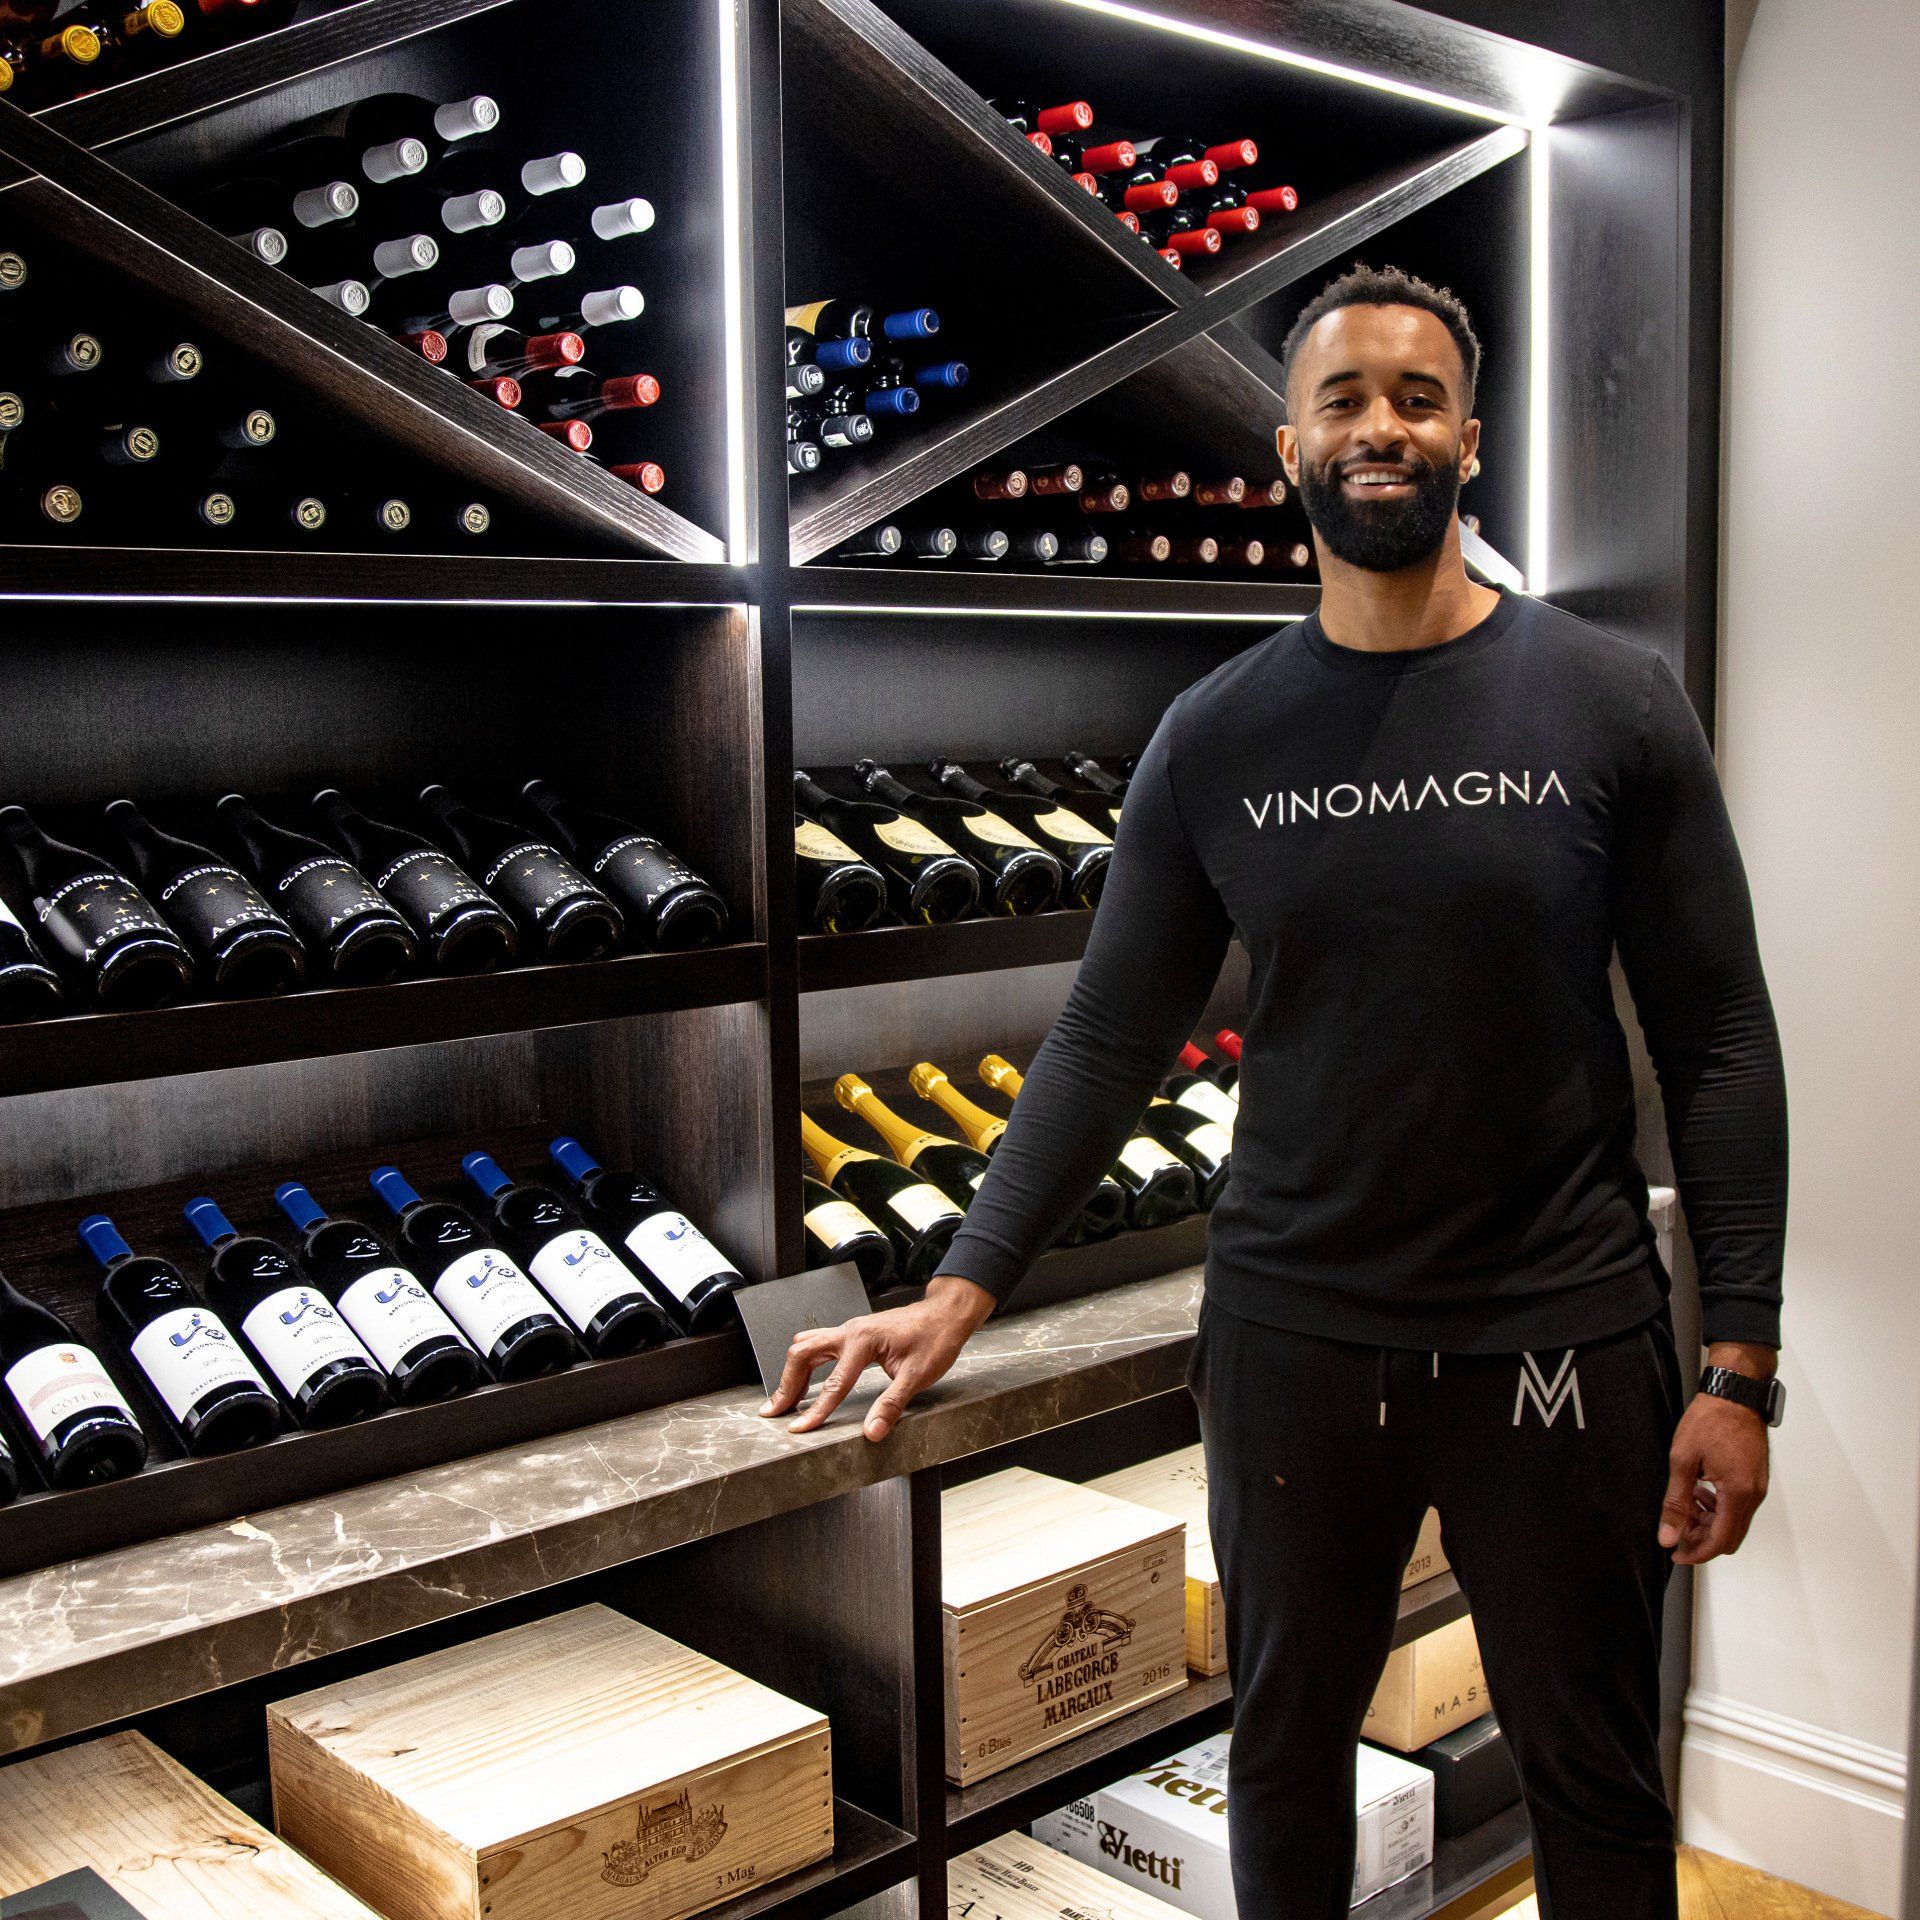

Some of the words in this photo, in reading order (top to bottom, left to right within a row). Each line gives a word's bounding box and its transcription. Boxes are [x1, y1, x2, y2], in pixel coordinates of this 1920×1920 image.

[1243, 769, 1571, 830] VINOMAGNA
[1408, 1555, 1432, 1576] 2013
[1057, 1642, 1098, 1671] CHATEAU
[1036, 1651, 1119, 1705] LABEGORCE
[1142, 1663, 1171, 1687] 2016
[1042, 1680, 1114, 1729] MARGAUX
[978, 1743, 986, 1758] 6
[671, 1845, 687, 1857] EGO
[1097, 1820, 1183, 1890] Vietti
[715, 1874, 723, 1890] 3
[727, 1865, 756, 1884] Mag
